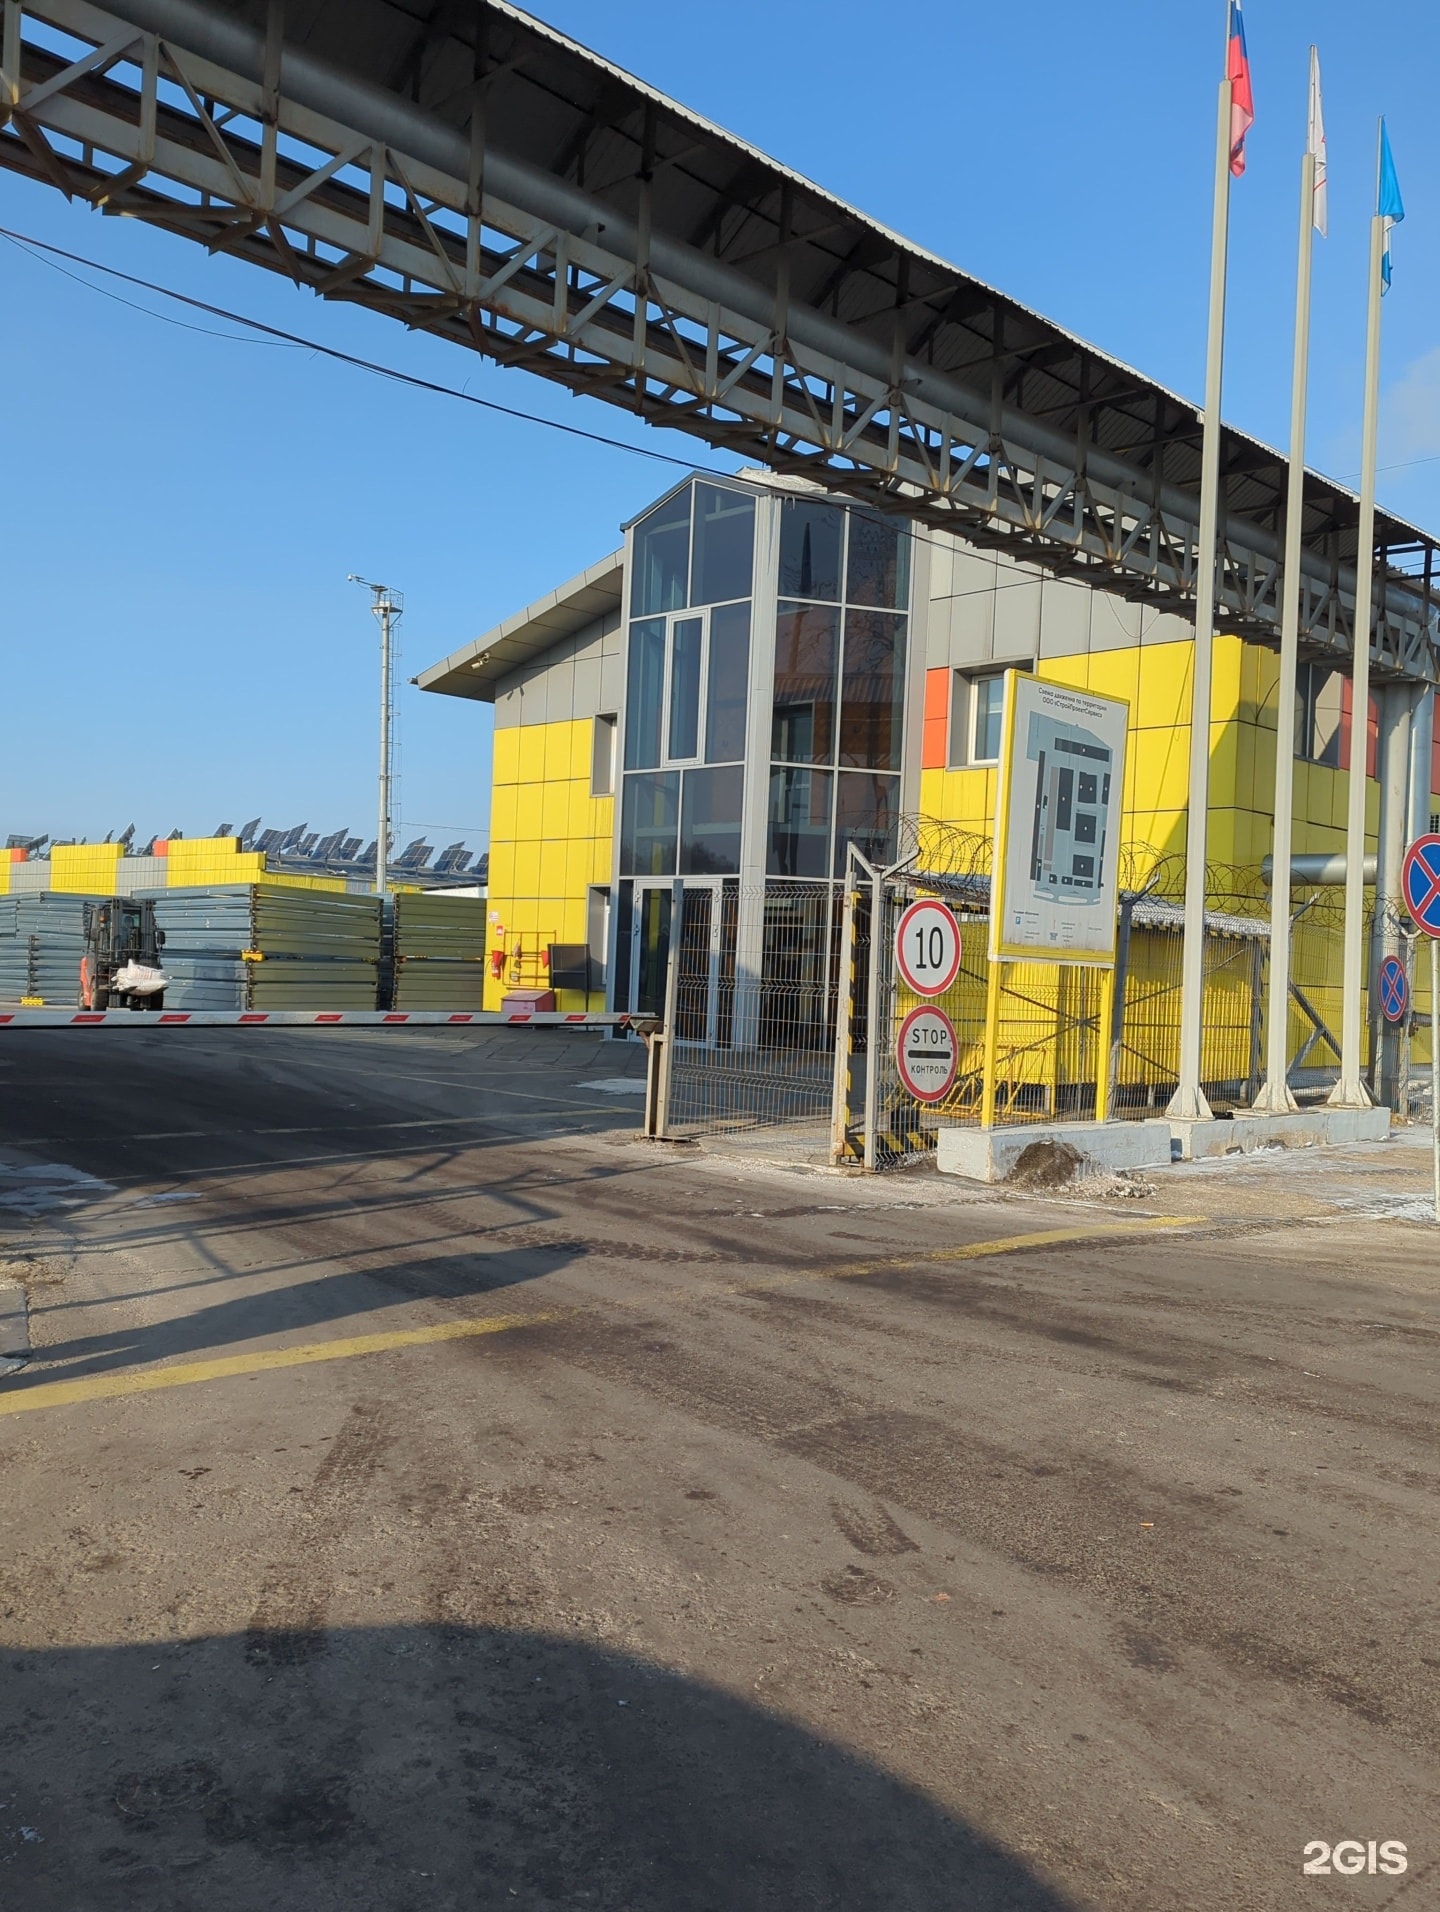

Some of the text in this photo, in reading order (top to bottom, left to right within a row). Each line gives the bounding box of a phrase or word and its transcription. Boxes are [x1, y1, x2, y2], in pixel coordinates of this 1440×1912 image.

[1038, 687, 1054, 697] Схема
[1054, 693, 1076, 703] движения
[1082, 700, 1107, 711] территории
[1042, 696, 1054, 705] ООО
[915, 926, 944, 969] 10
[912, 1028, 947, 1044] STOP
[911, 1064, 948, 1075] КОНТРОЛЬ
